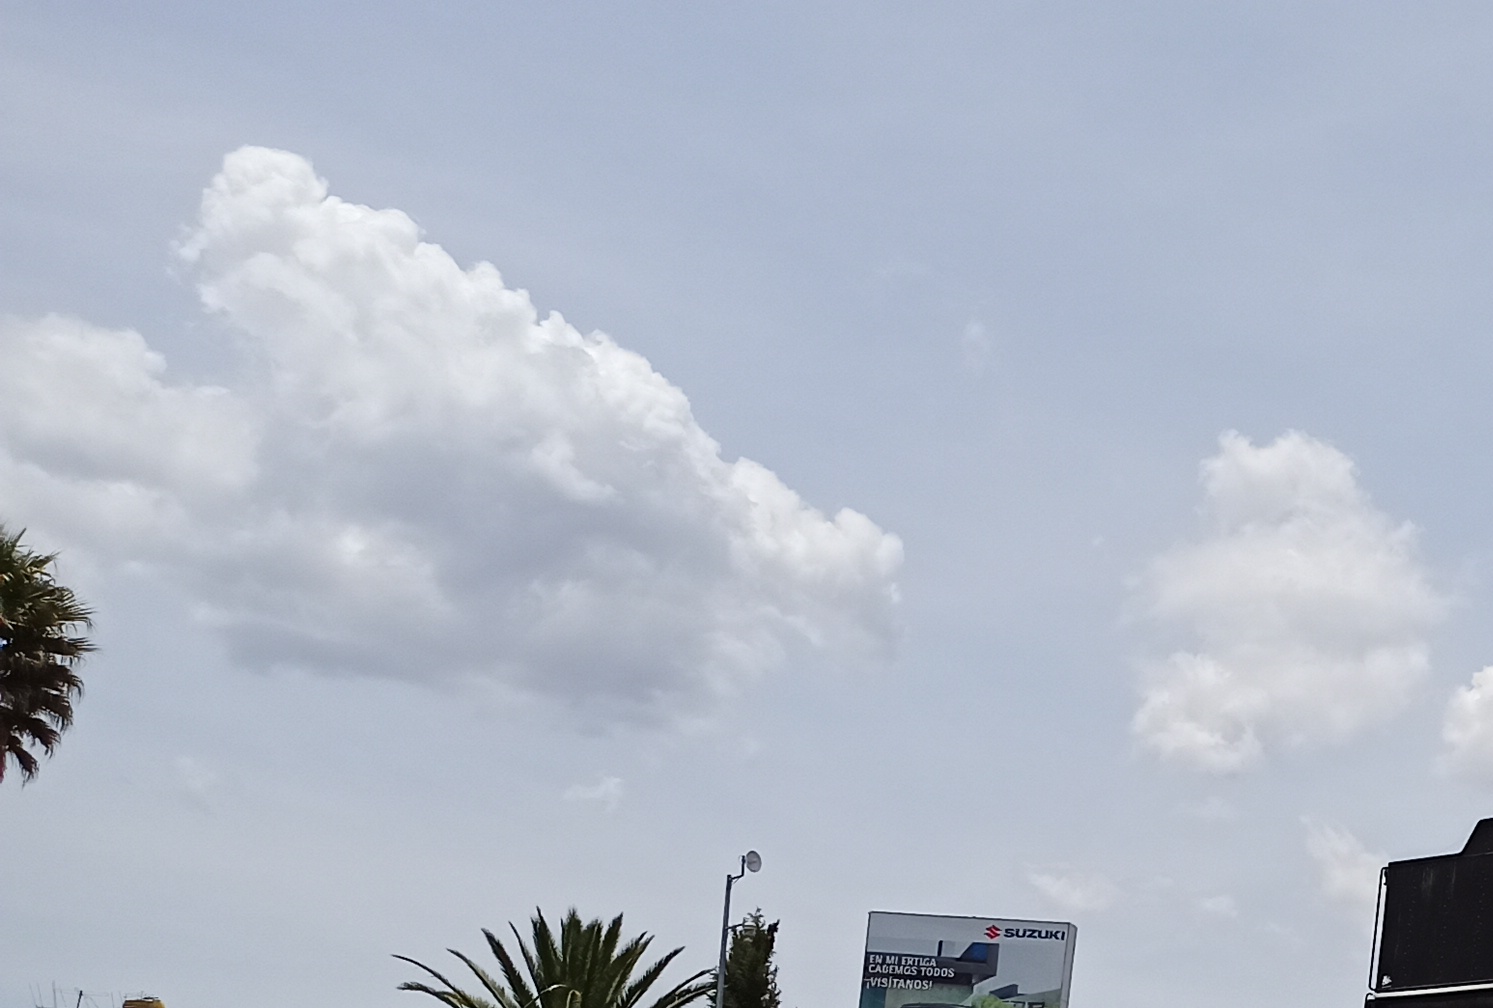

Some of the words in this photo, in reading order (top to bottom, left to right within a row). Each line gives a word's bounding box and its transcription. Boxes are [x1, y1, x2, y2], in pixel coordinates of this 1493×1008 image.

[1003, 928, 1066, 941] SUZUKI
[869, 954, 884, 965] EN
[886, 955, 898, 966] MI
[901, 956, 937, 968] ERTIGA
[920, 967, 955, 978] TODOS
